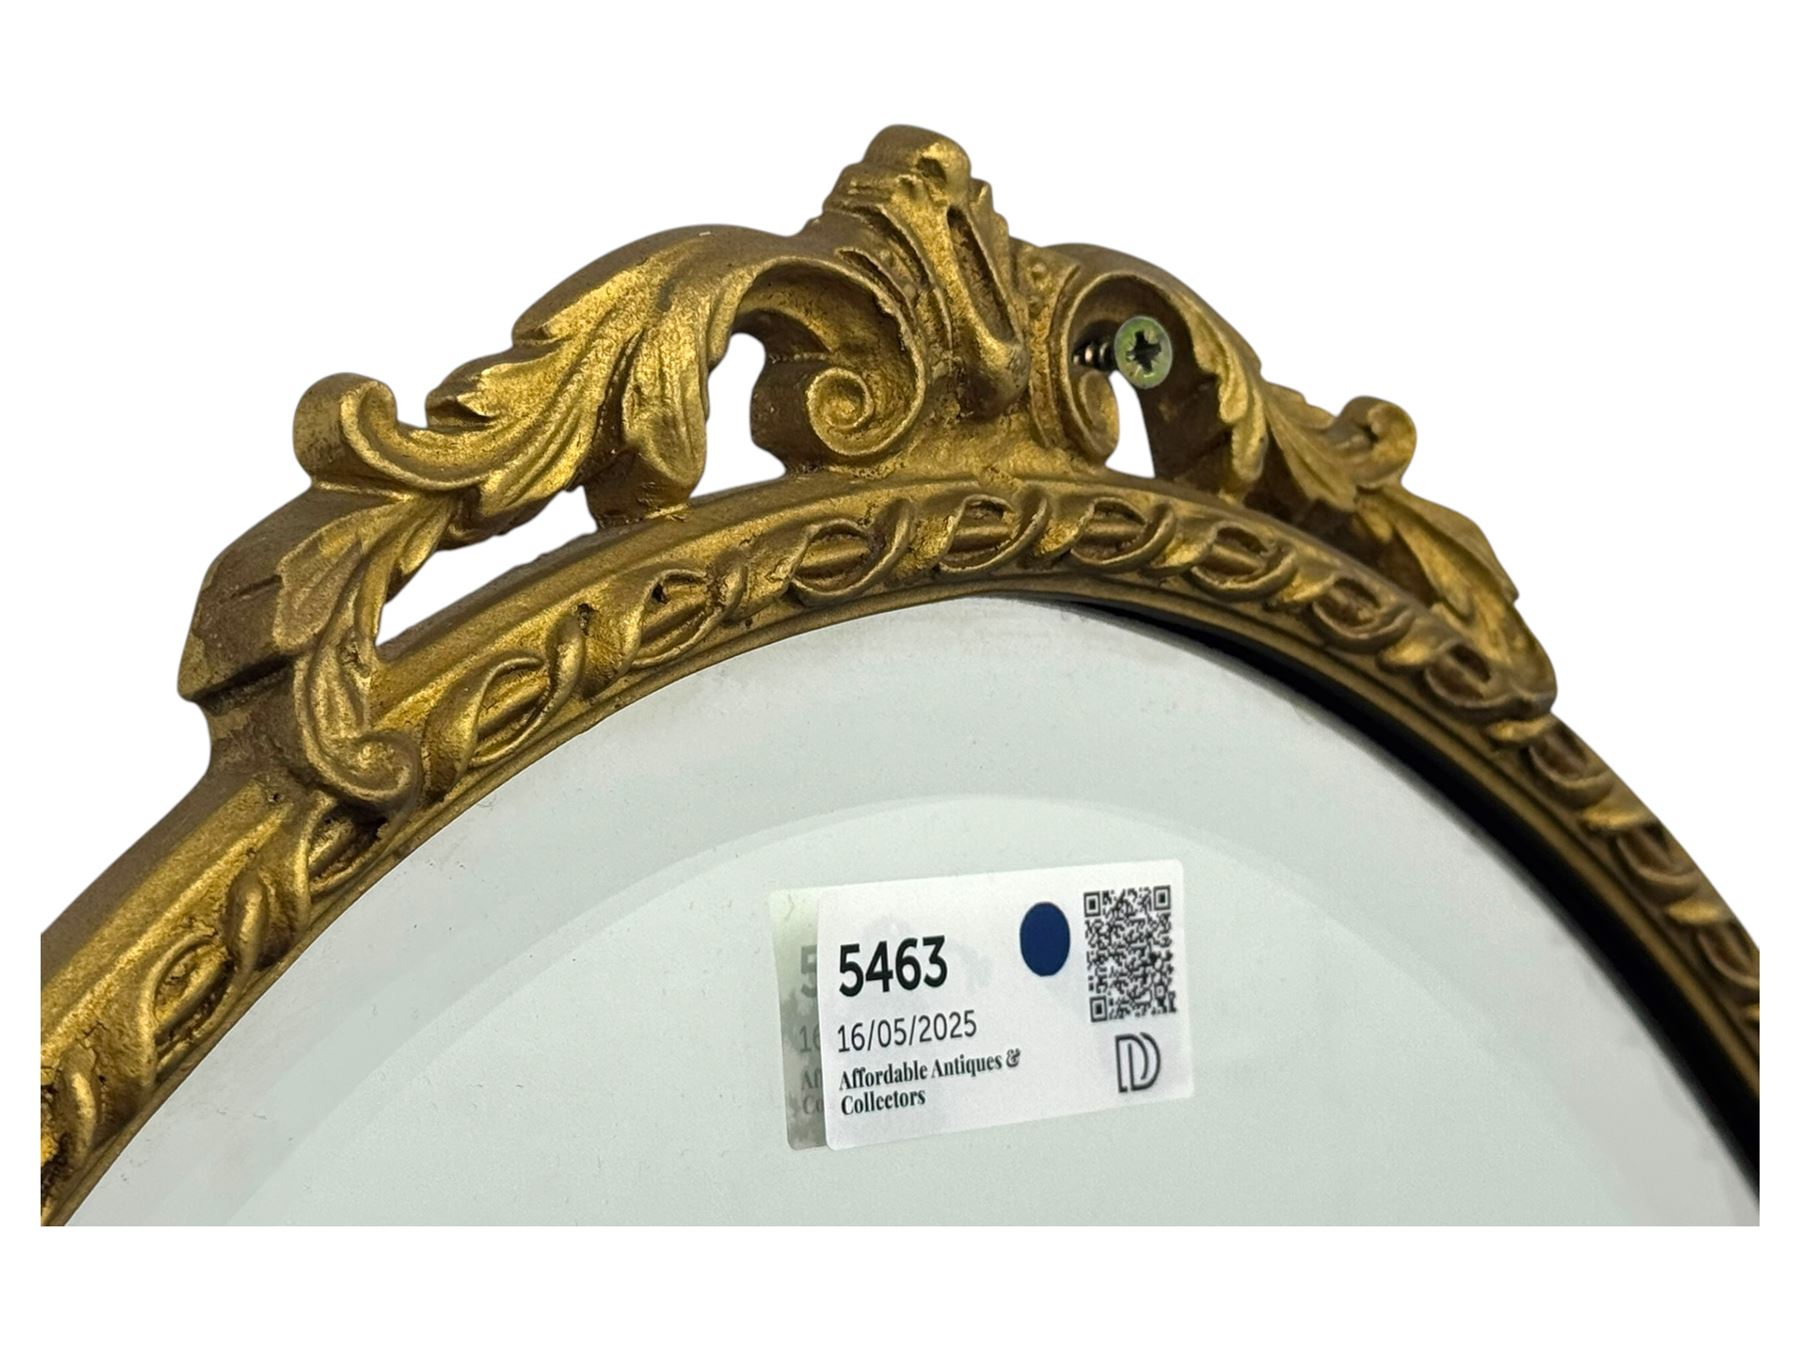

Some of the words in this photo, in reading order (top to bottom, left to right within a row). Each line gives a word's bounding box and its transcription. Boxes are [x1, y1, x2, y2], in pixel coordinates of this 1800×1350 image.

[838, 935, 948, 997] 5463
[837, 1009, 977, 1053] 16/05/2025
[838, 1060, 928, 1091] Affordable
[930, 1054, 1003, 1079] Antiques
[1005, 1048, 1021, 1068] &
[840, 1089, 926, 1115] Collectors
